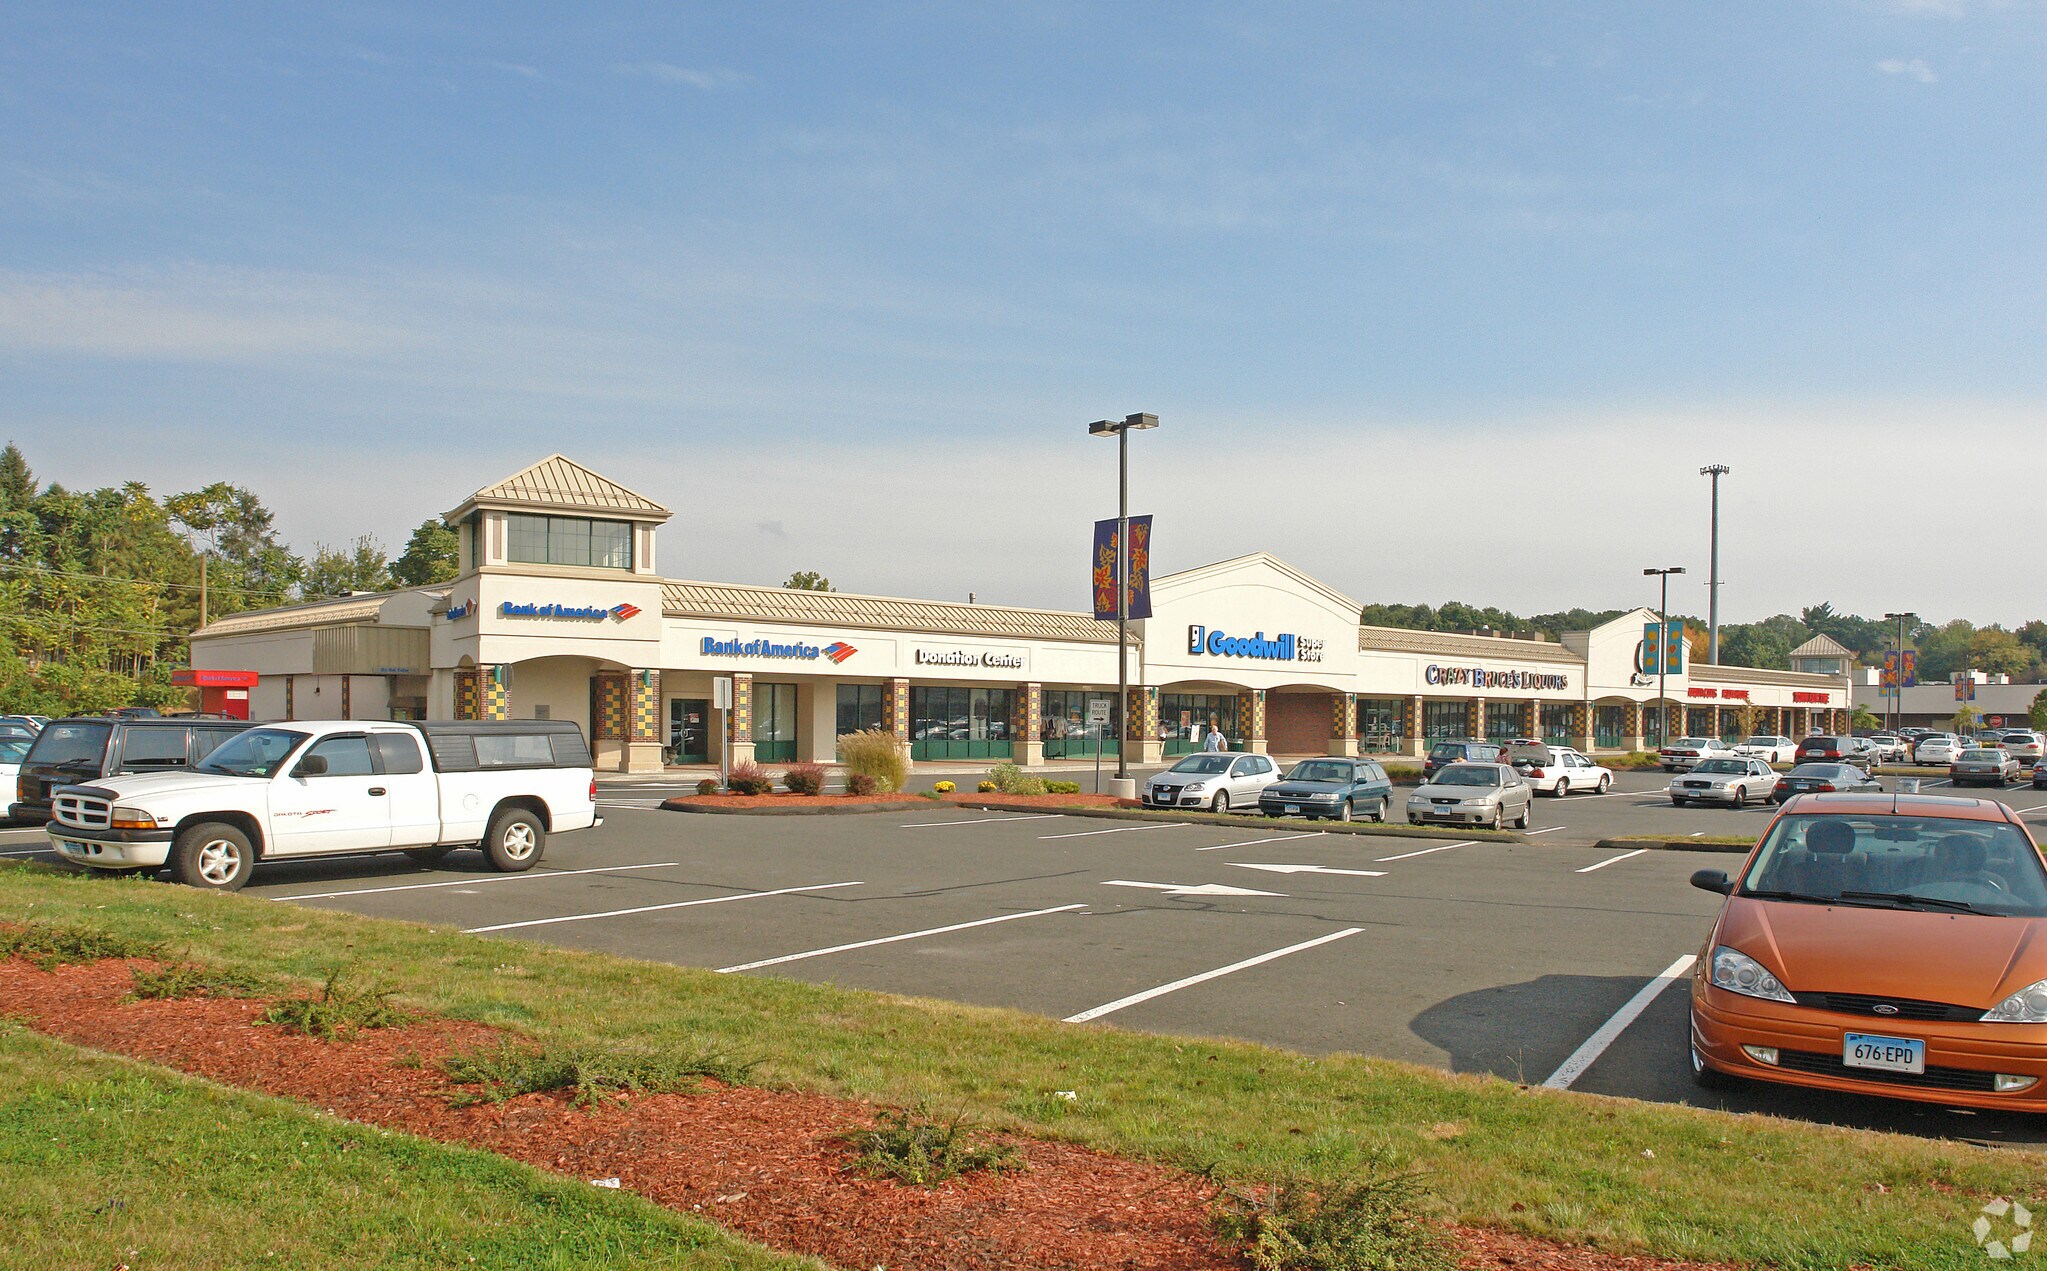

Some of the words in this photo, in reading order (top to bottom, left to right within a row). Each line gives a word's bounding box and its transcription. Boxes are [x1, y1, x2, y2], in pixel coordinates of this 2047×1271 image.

[503, 601, 537, 615] Bank
[539, 603, 553, 616] of
[554, 604, 608, 619] America
[703, 637, 743, 654] Bank
[744, 639, 760, 655] of
[761, 640, 819, 657] America
[1208, 630, 1295, 660] Goodwill
[1298, 636, 1326, 650] Super
[917, 649, 979, 666] Donation
[982, 652, 1025, 668] Center
[1298, 649, 1325, 662] Store
[1425, 664, 1471, 686] CRAZY
[1472, 668, 1520, 689] BRUCE'S
[1521, 671, 1568, 691] LIQUORS
